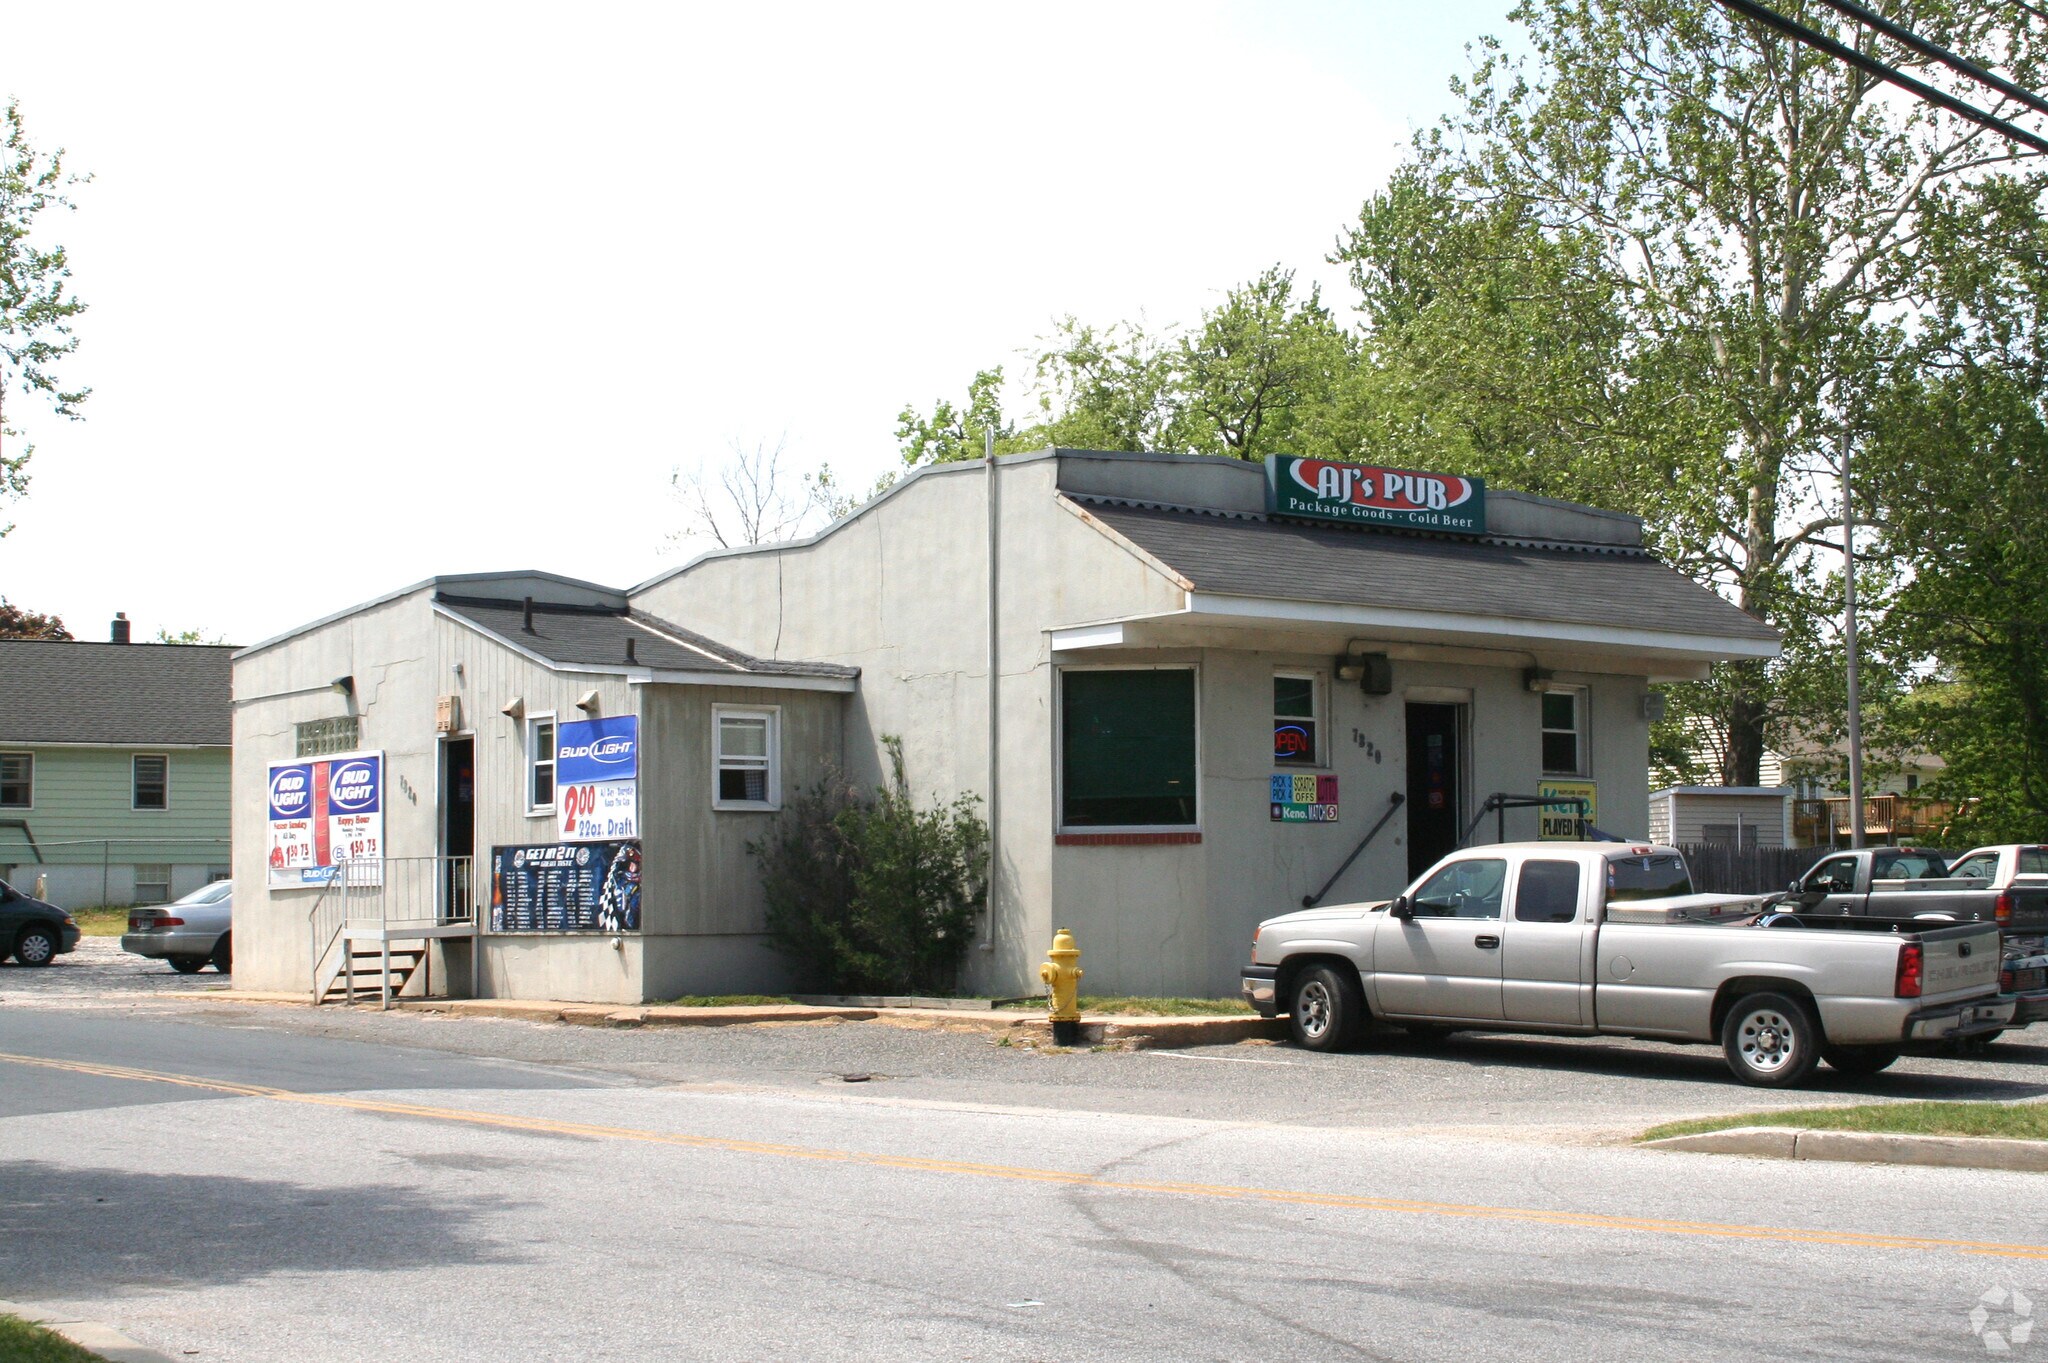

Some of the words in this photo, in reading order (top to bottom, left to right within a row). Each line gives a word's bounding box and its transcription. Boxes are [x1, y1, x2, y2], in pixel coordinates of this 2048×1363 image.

[1318, 466, 1373, 503] AJ's
[1383, 473, 1447, 510] PUB
[1289, 497, 1347, 516] Package
[1352, 506, 1393, 520] Goods
[1409, 512, 1438, 525] Cold
[1442, 514, 1474, 528] Beer
[559, 747, 588, 758] BUD
[594, 742, 632, 755] LIGHT
[279, 777, 304, 791] BUD
[341, 770, 370, 784] BUD
[1294, 777, 1315, 791] SCRATCH
[275, 792, 306, 806] LIGHT
[336, 785, 373, 800] LIGHT
[1295, 792, 1315, 802] OFFS
[1283, 806, 1308, 819] Keno.
[1308, 804, 1326, 820] MATCH
[1329, 807, 1336, 818] 5
[578, 820, 604, 836] 22oz.
[607, 817, 633, 836] Draft
[1543, 818, 1573, 836] PLAYED
[525, 848, 546, 860] GET
[556, 846, 566, 860] 2
[303, 869, 321, 878] BUD
